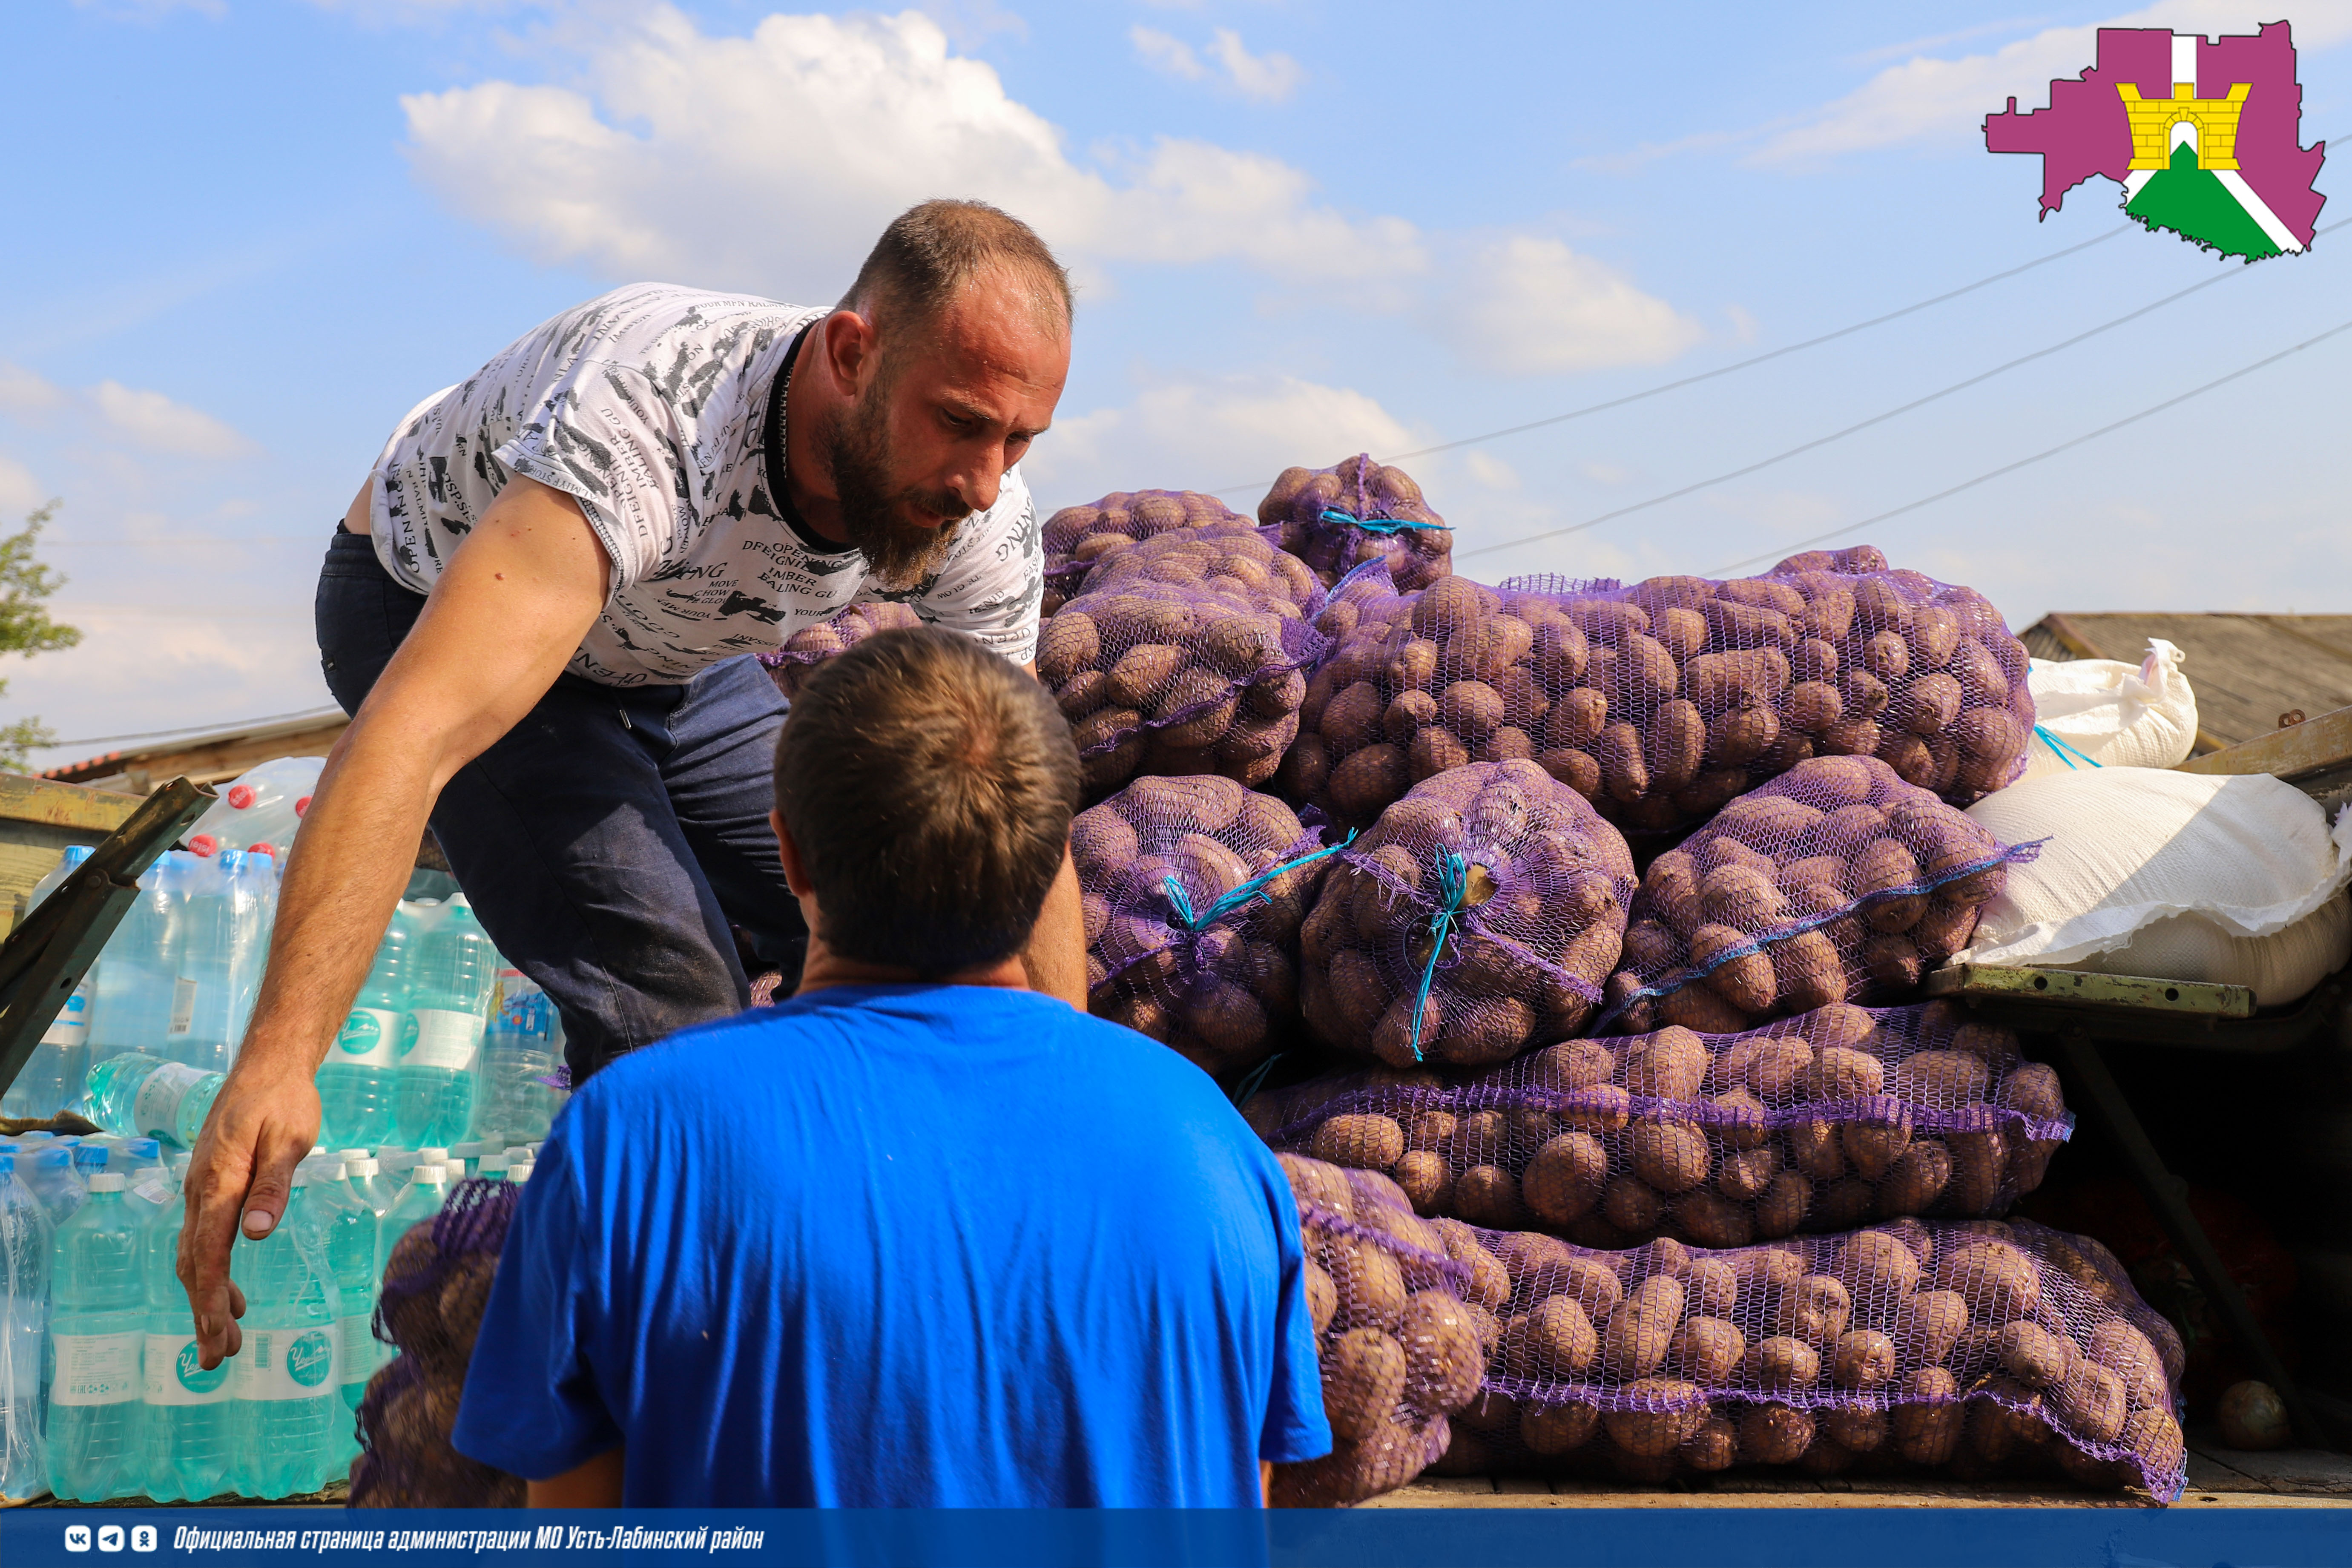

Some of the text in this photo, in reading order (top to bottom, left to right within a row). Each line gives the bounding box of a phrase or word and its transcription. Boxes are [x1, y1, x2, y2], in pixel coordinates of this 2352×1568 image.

[601, 408, 621, 425] GU
[610, 434, 647, 488] IMBER
[708, 579, 739, 588] MOVE
[757, 571, 838, 598] EALING GU
[768, 567, 817, 586] IMBER
[937, 584, 965, 600] GLOW
[681, 609, 712, 619] YOUR
[794, 608, 824, 617] YOUR
